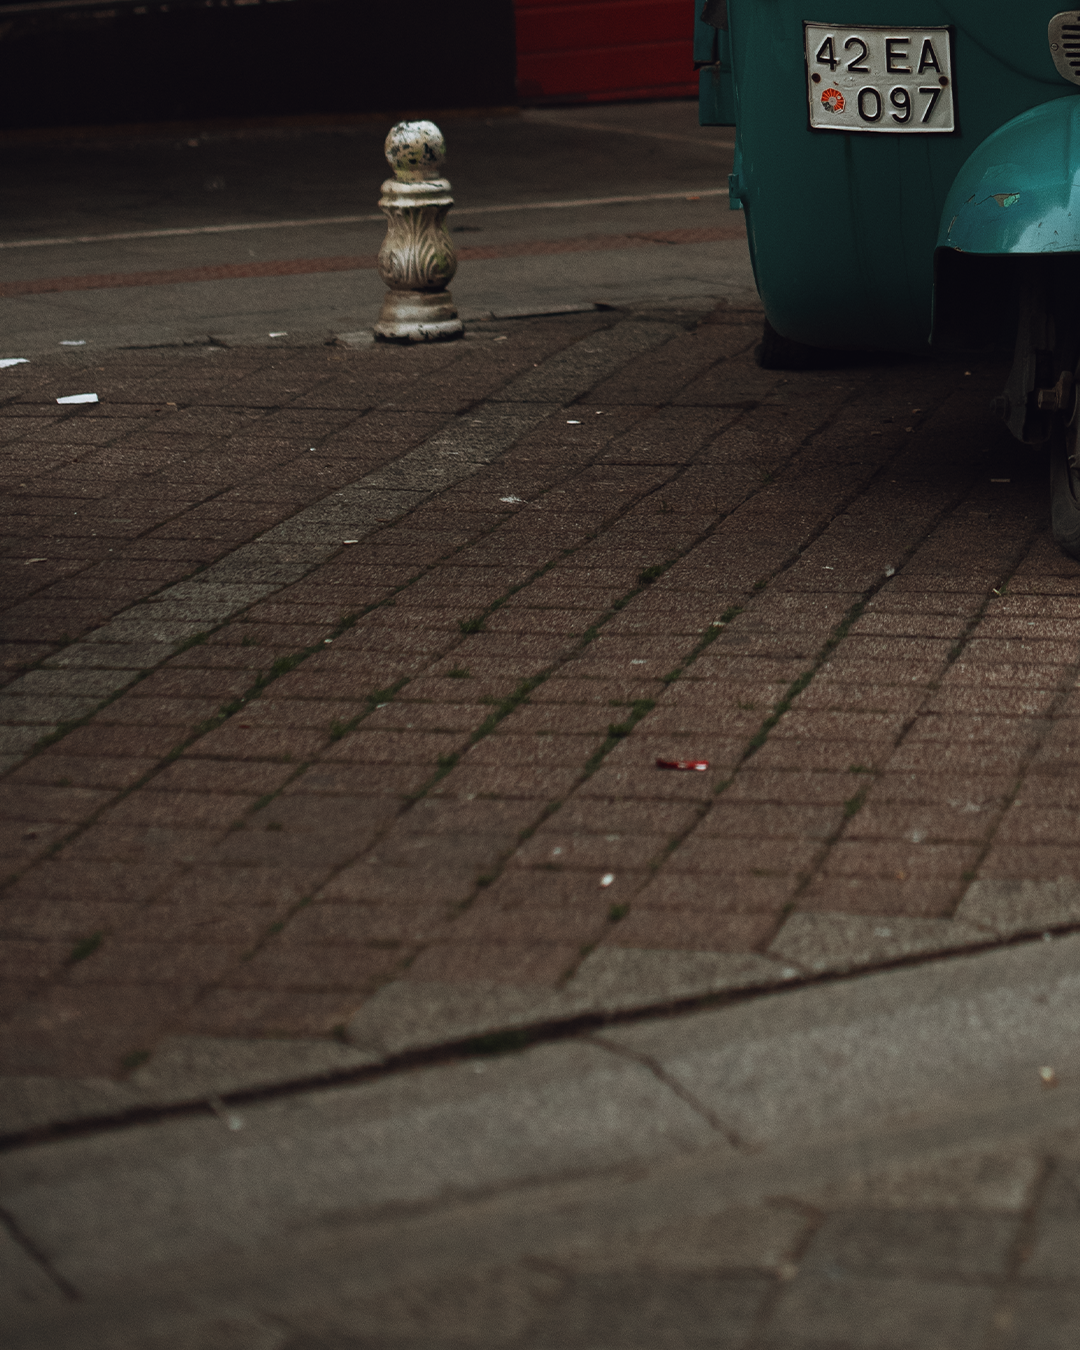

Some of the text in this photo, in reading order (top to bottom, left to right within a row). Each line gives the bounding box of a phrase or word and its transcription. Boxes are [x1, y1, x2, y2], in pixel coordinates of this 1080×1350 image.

[815, 36, 941, 73] 42 EA
[857, 86, 941, 123] 097
